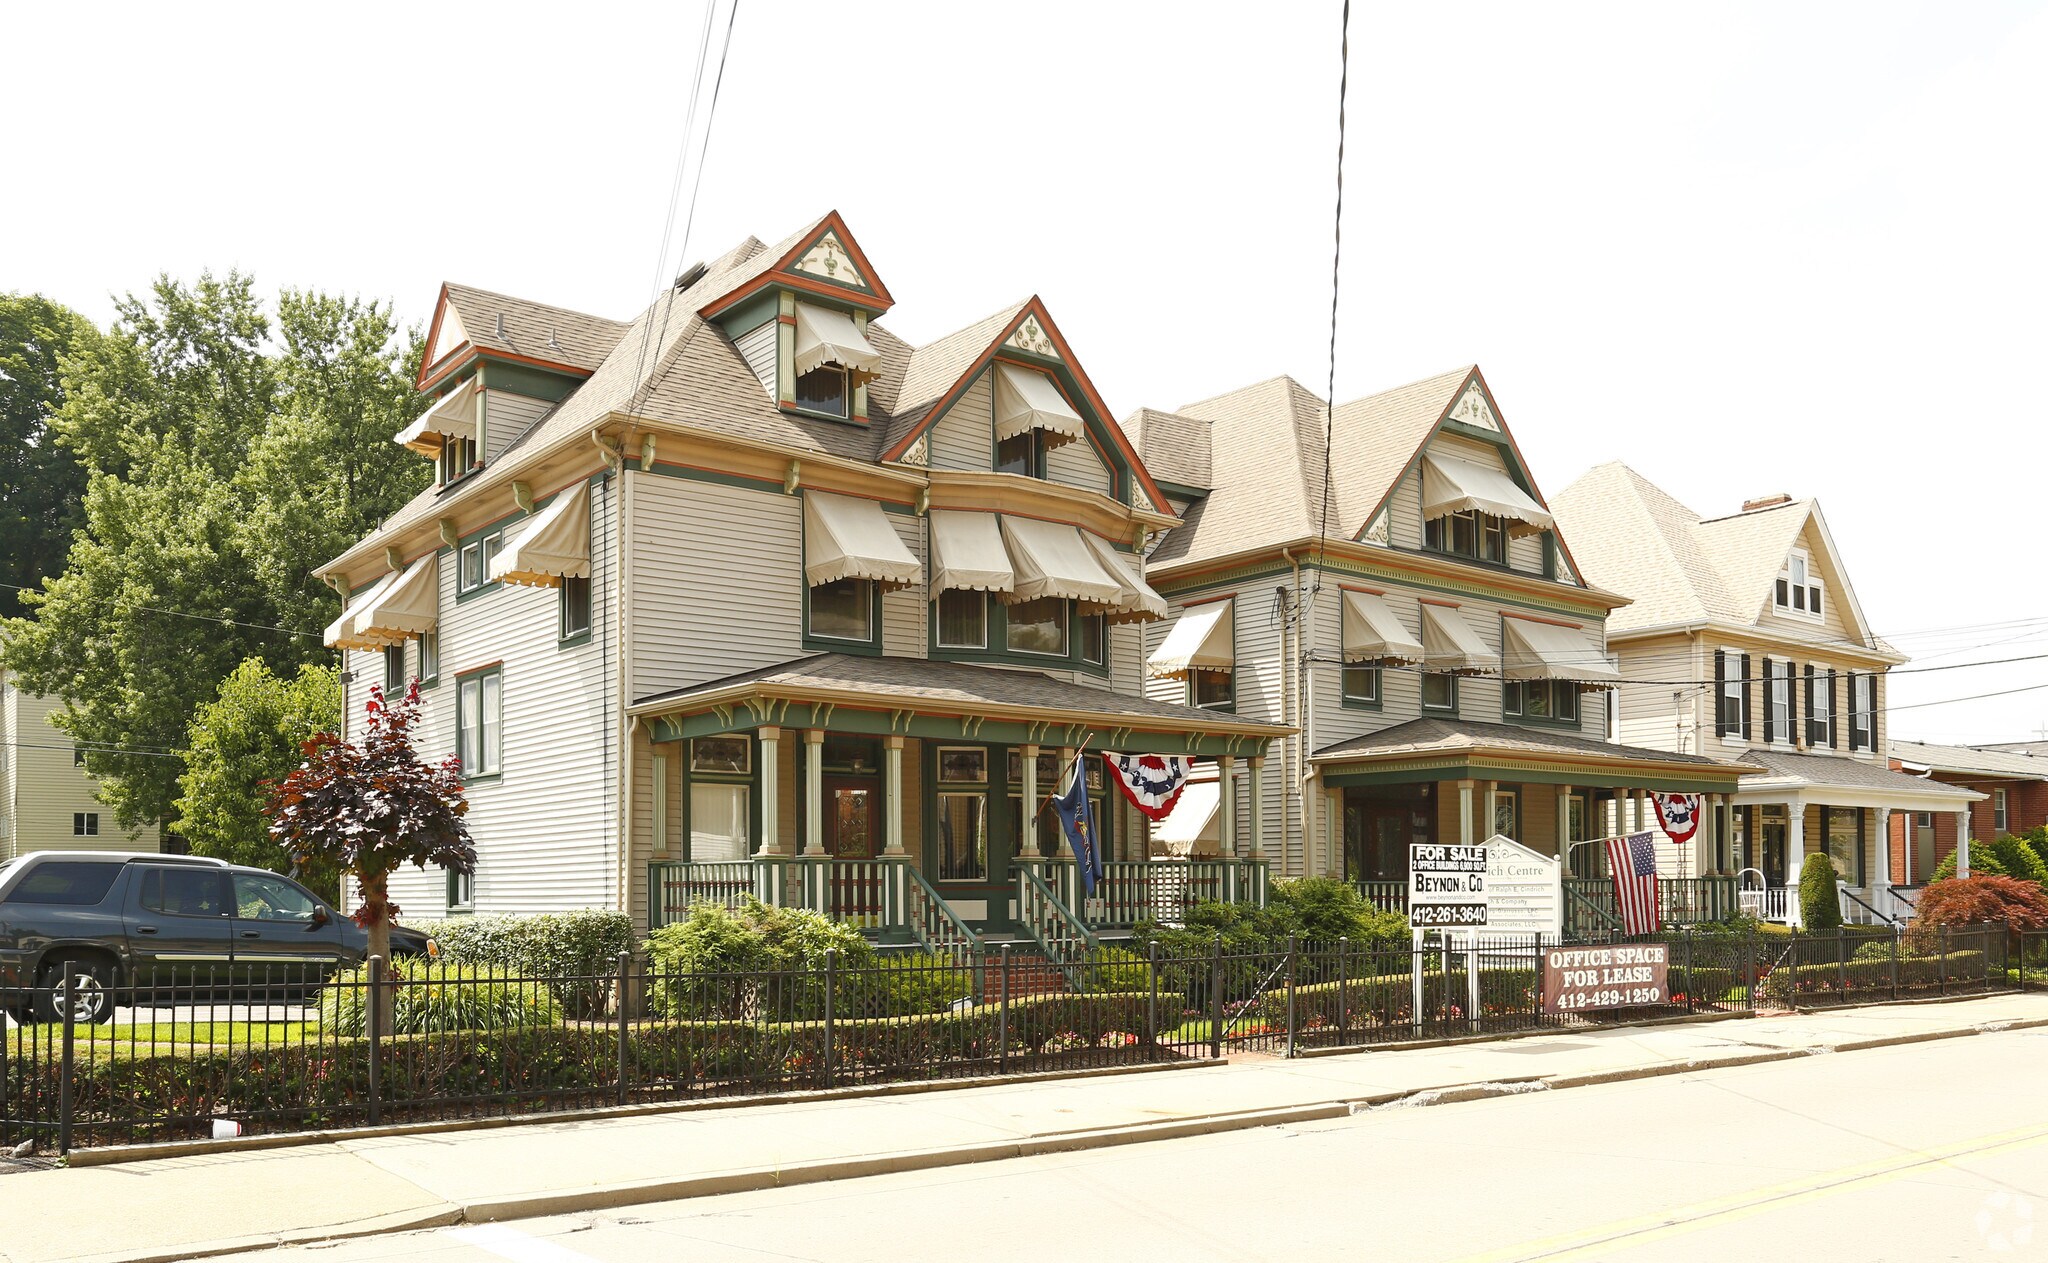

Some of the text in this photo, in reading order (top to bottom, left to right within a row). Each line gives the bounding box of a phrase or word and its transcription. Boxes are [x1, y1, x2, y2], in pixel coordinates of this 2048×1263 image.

[1416, 847, 1484, 861] FOR SALE
[1413, 860, 1417, 870] 2
[1418, 860, 1435, 870] OFFICE
[1436, 861, 1459, 870] BUILDINGS
[1508, 865, 1544, 876] Centre
[1415, 873, 1460, 892] BEYNON
[1461, 881, 1466, 892] &
[1501, 898, 1527, 906] Company
[1412, 906, 1486, 923] 412-261-3640
[1549, 947, 1664, 969] OFFICE SPACE
[1563, 966, 1653, 988] FOR LEASE
[1557, 987, 1660, 1009] 412-429-1250
